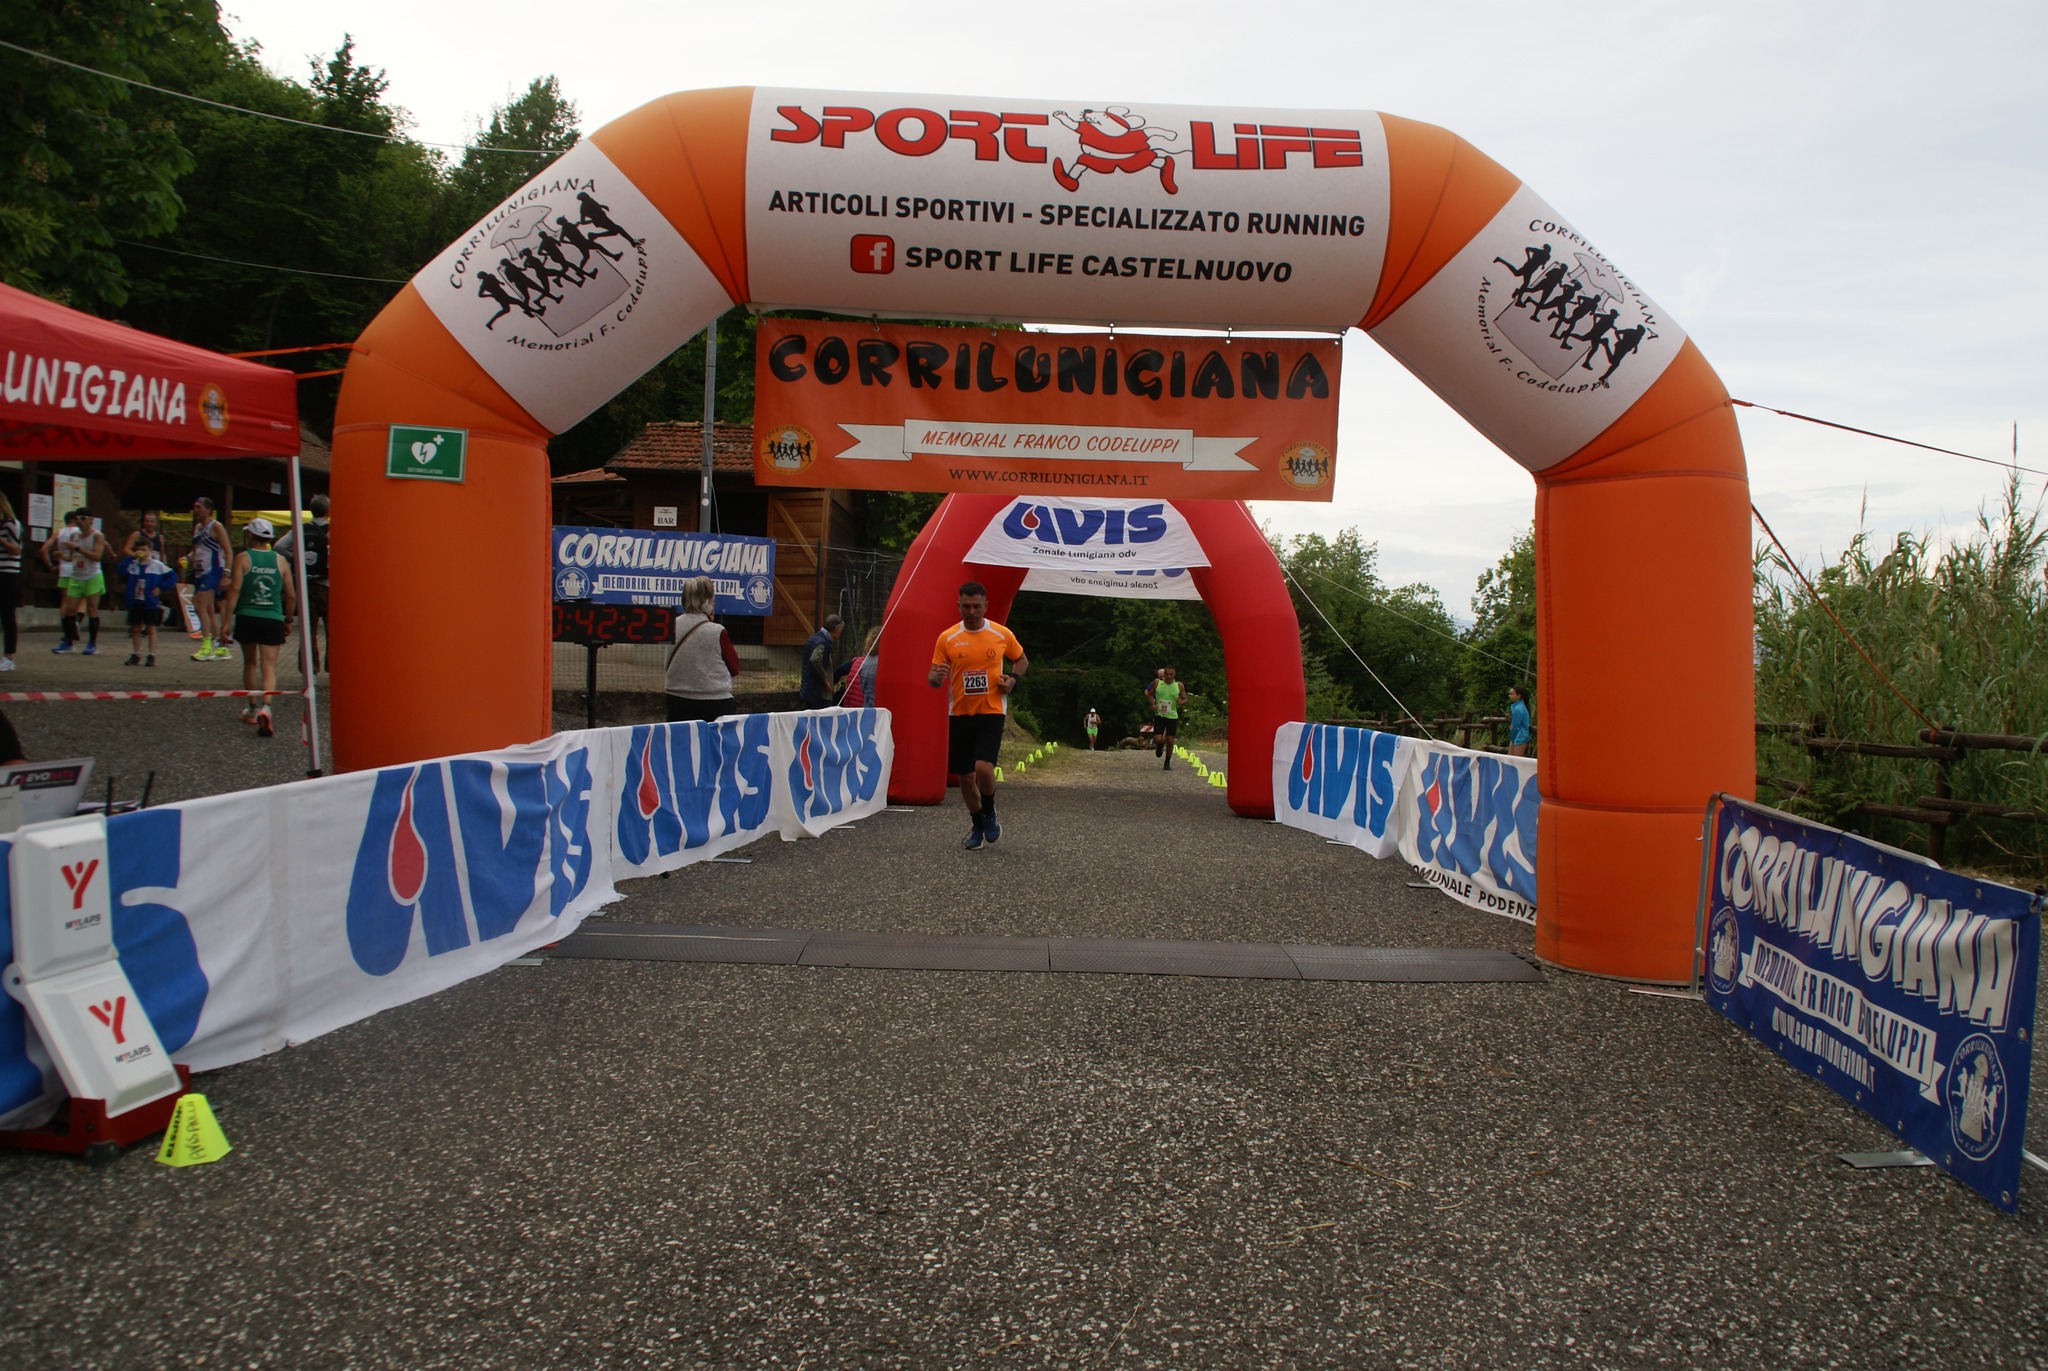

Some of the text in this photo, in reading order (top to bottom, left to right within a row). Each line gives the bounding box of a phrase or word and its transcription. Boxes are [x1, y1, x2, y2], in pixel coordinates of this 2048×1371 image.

[770, 105, 1049, 164] SPORT
[449, 177, 596, 290] CORRILUNIGIANA
[768, 189, 889, 218] ARTICOLI
[895, 196, 1015, 225] SPORTIVI
[1039, 203, 1241, 234] SPECIALIZZATO
[1247, 212, 1366, 238] RUNNING
[905, 246, 1003, 273] SPORT
[1010, 252, 1074, 276] LIFE
[1082, 254, 1293, 284] CASTELNUOVO
[1528, 219, 1659, 341] CORRILUNIGIANA
[1477, 275, 1502, 355] Memorial
[506, 332, 594, 351] Memorial
[0, 350, 187, 425] UNIGIANA
[768, 334, 1330, 401] CORRILUNIGIANA
[921, 430, 1180, 454] MEMORIAL FRANCO CODELUPPI
[948, 468, 1150, 487] WWW.CORRILUNIGIANA.IT
[657, 516, 675, 525] BAR
[1002, 501, 1168, 546] AVIS
[558, 533, 770, 576] CORRILUNIGIANA
[1032, 546, 1137, 560] Zonale Lunigiana odv
[602, 576, 651, 591] MEMORIAL
[655, 578, 684, 592] FRANC
[964, 676, 987, 688] 2263
[616, 712, 773, 866] AVIS
[788, 707, 883, 824] AVIS
[1288, 723, 1398, 839] AVIS
[345, 746, 593, 977] AVIS
[1412, 864, 1538, 920] OMUNALE PODENZ
[64, 912, 102, 930] MYLAPS
[1801, 970, 1854, 1028] FRANCO
[115, 1043, 152, 1063] MYLAPS
